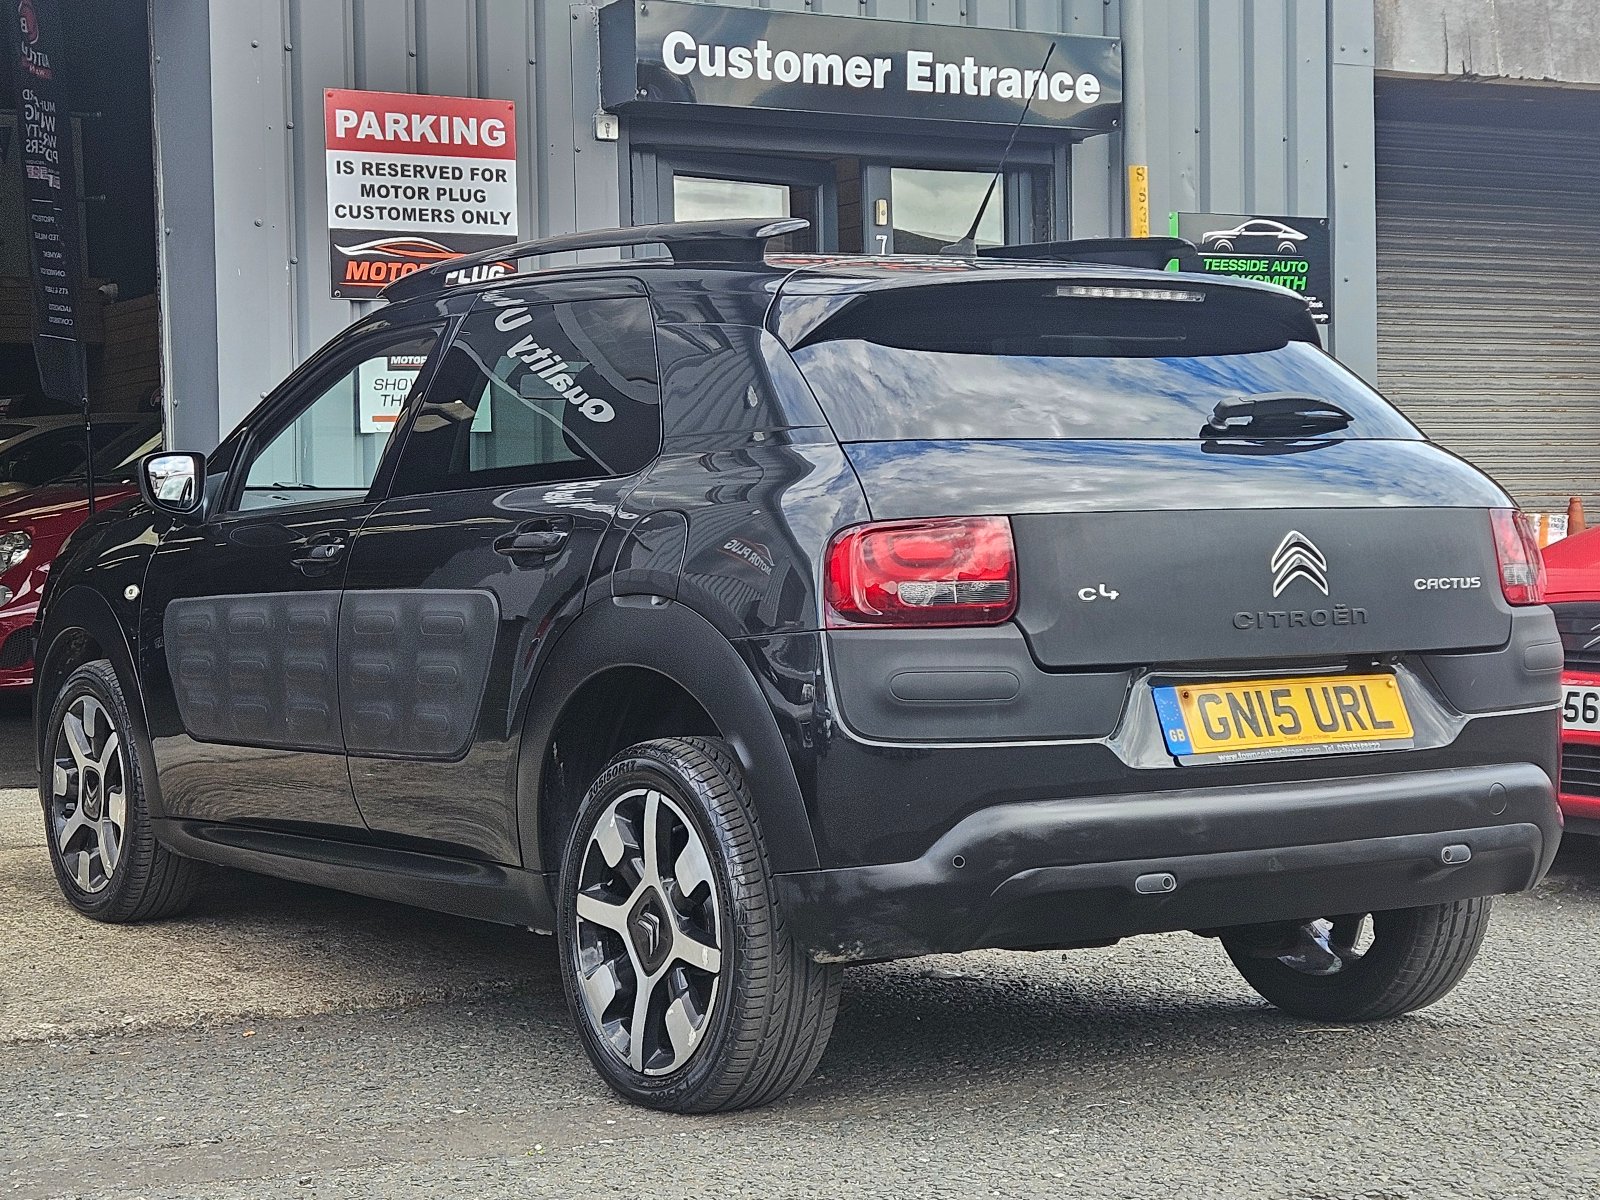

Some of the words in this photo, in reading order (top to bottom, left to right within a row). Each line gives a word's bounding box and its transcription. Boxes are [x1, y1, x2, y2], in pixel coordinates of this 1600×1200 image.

[662, 31, 892, 90] Customer
[906, 49, 1101, 104] Entrance
[335, 109, 506, 147] PARKING
[335, 160, 354, 175] IS
[361, 162, 463, 181] RESERVED
[470, 167, 507, 183] FOR
[360, 184, 430, 201] MOTOR
[436, 188, 487, 204] PLUG
[334, 205, 455, 223] CUSTOMERS
[462, 210, 511, 226] ONLY
[875, 235, 888, 255] 7
[1203, 258, 1269, 272] TEESSIDE
[1271, 260, 1309, 273] AUTO
[1414, 576, 1481, 591] CACTUS
[1197, 688, 1302, 741] GN15
[1305, 685, 1395, 732] URL
[1563, 691, 1600, 724] 56
[1169, 729, 1186, 743] GB
